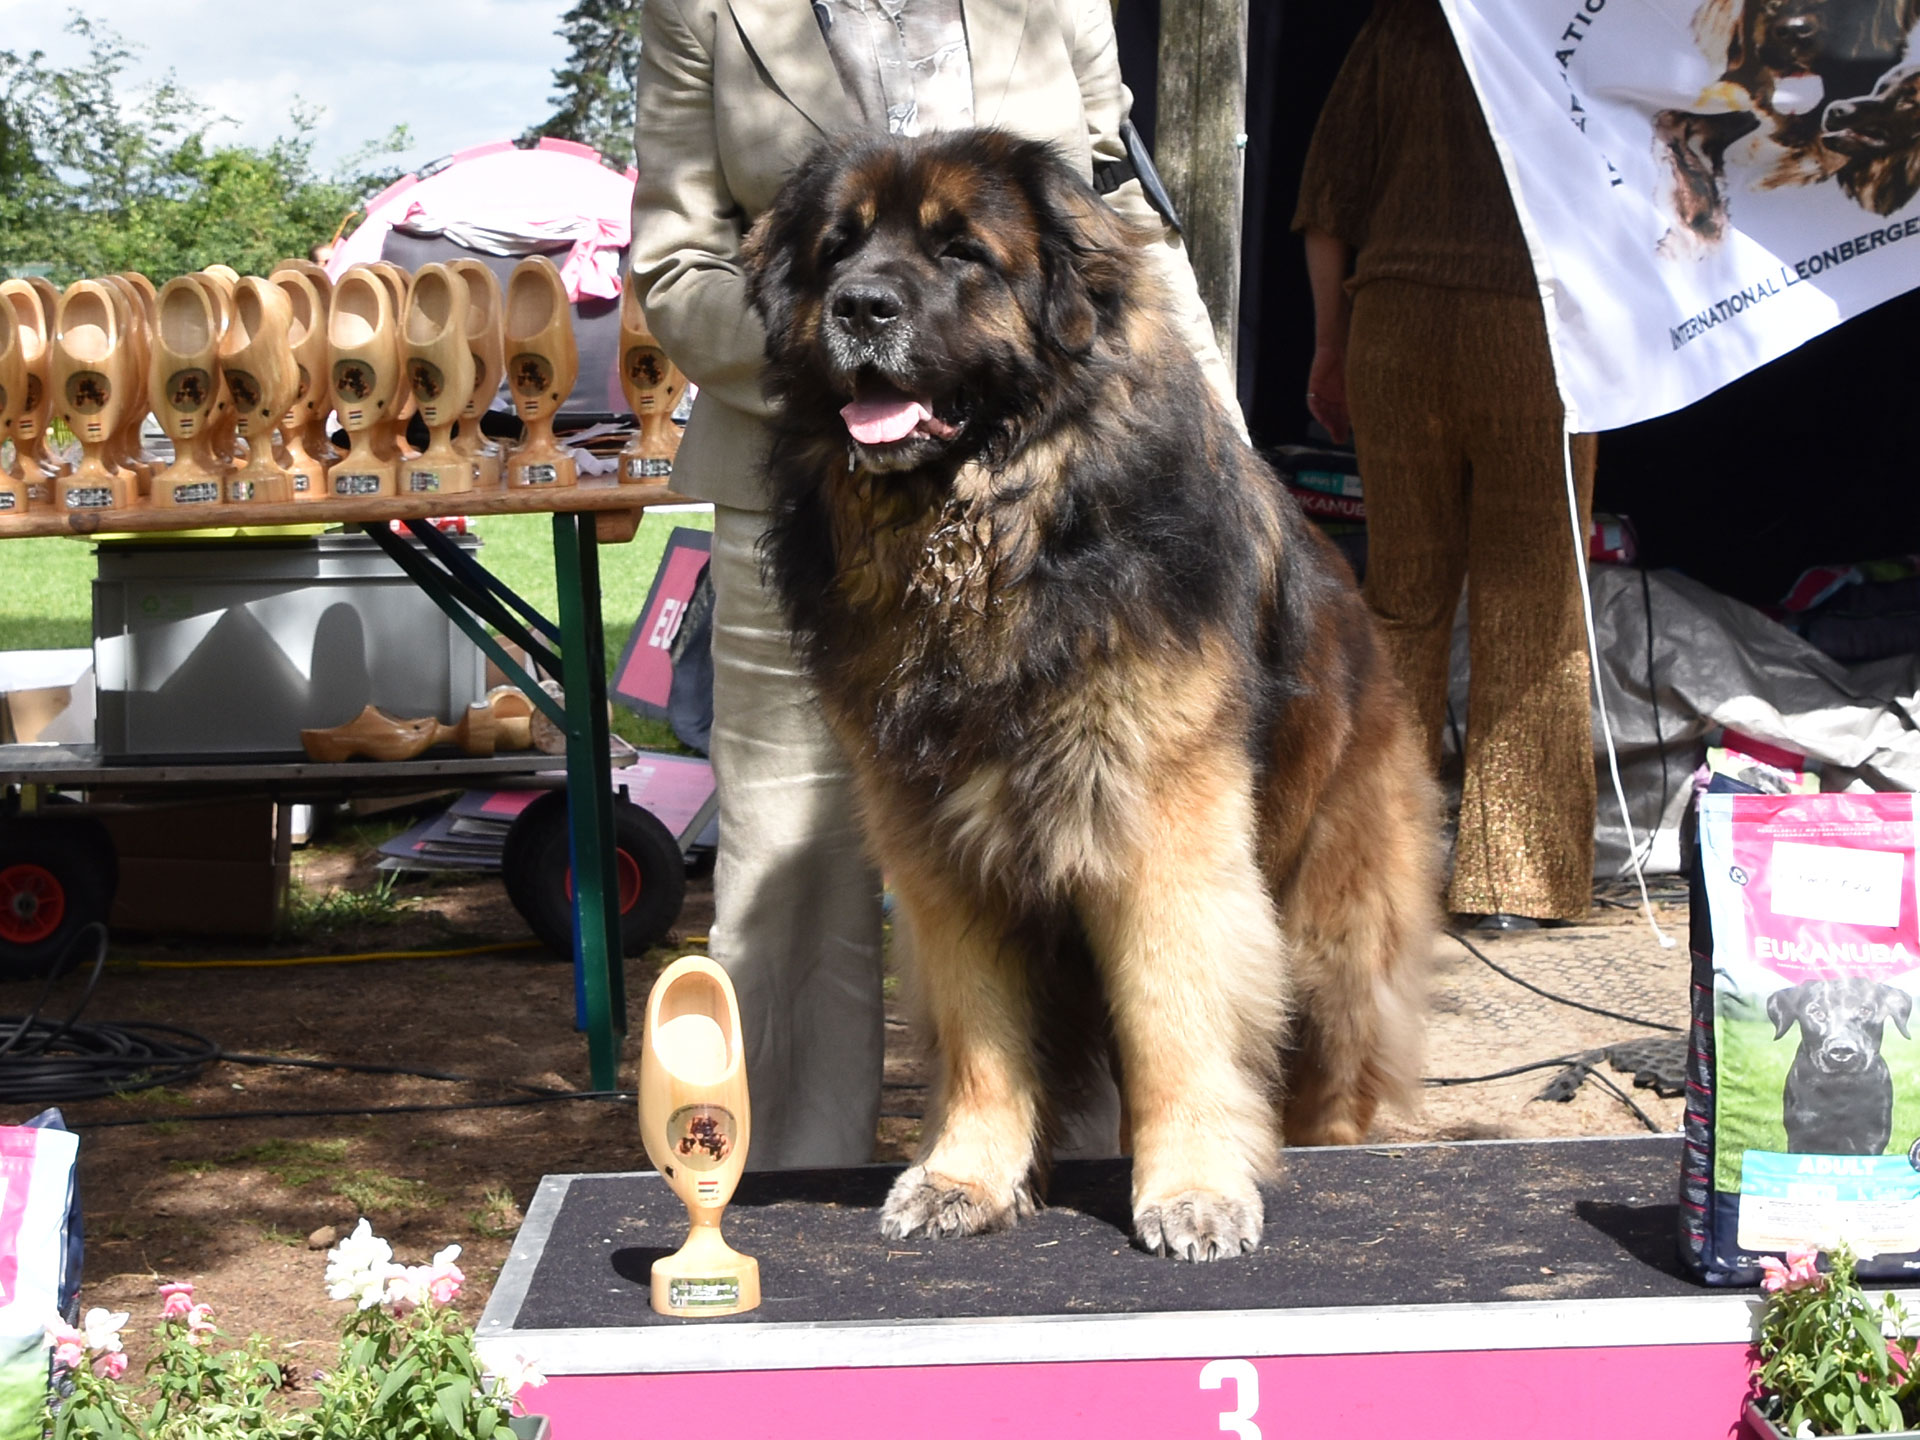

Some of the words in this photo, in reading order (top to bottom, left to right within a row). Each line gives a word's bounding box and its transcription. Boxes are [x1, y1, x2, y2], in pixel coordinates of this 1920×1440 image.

[1669, 278, 1780, 351] INTERNATIONAL
[1781, 217, 1920, 287] LEONBERGE
[1755, 936, 1912, 966] EUKANUBA
[1797, 1156, 1877, 1176] ADULT
[1199, 1359, 1263, 1440] 3
